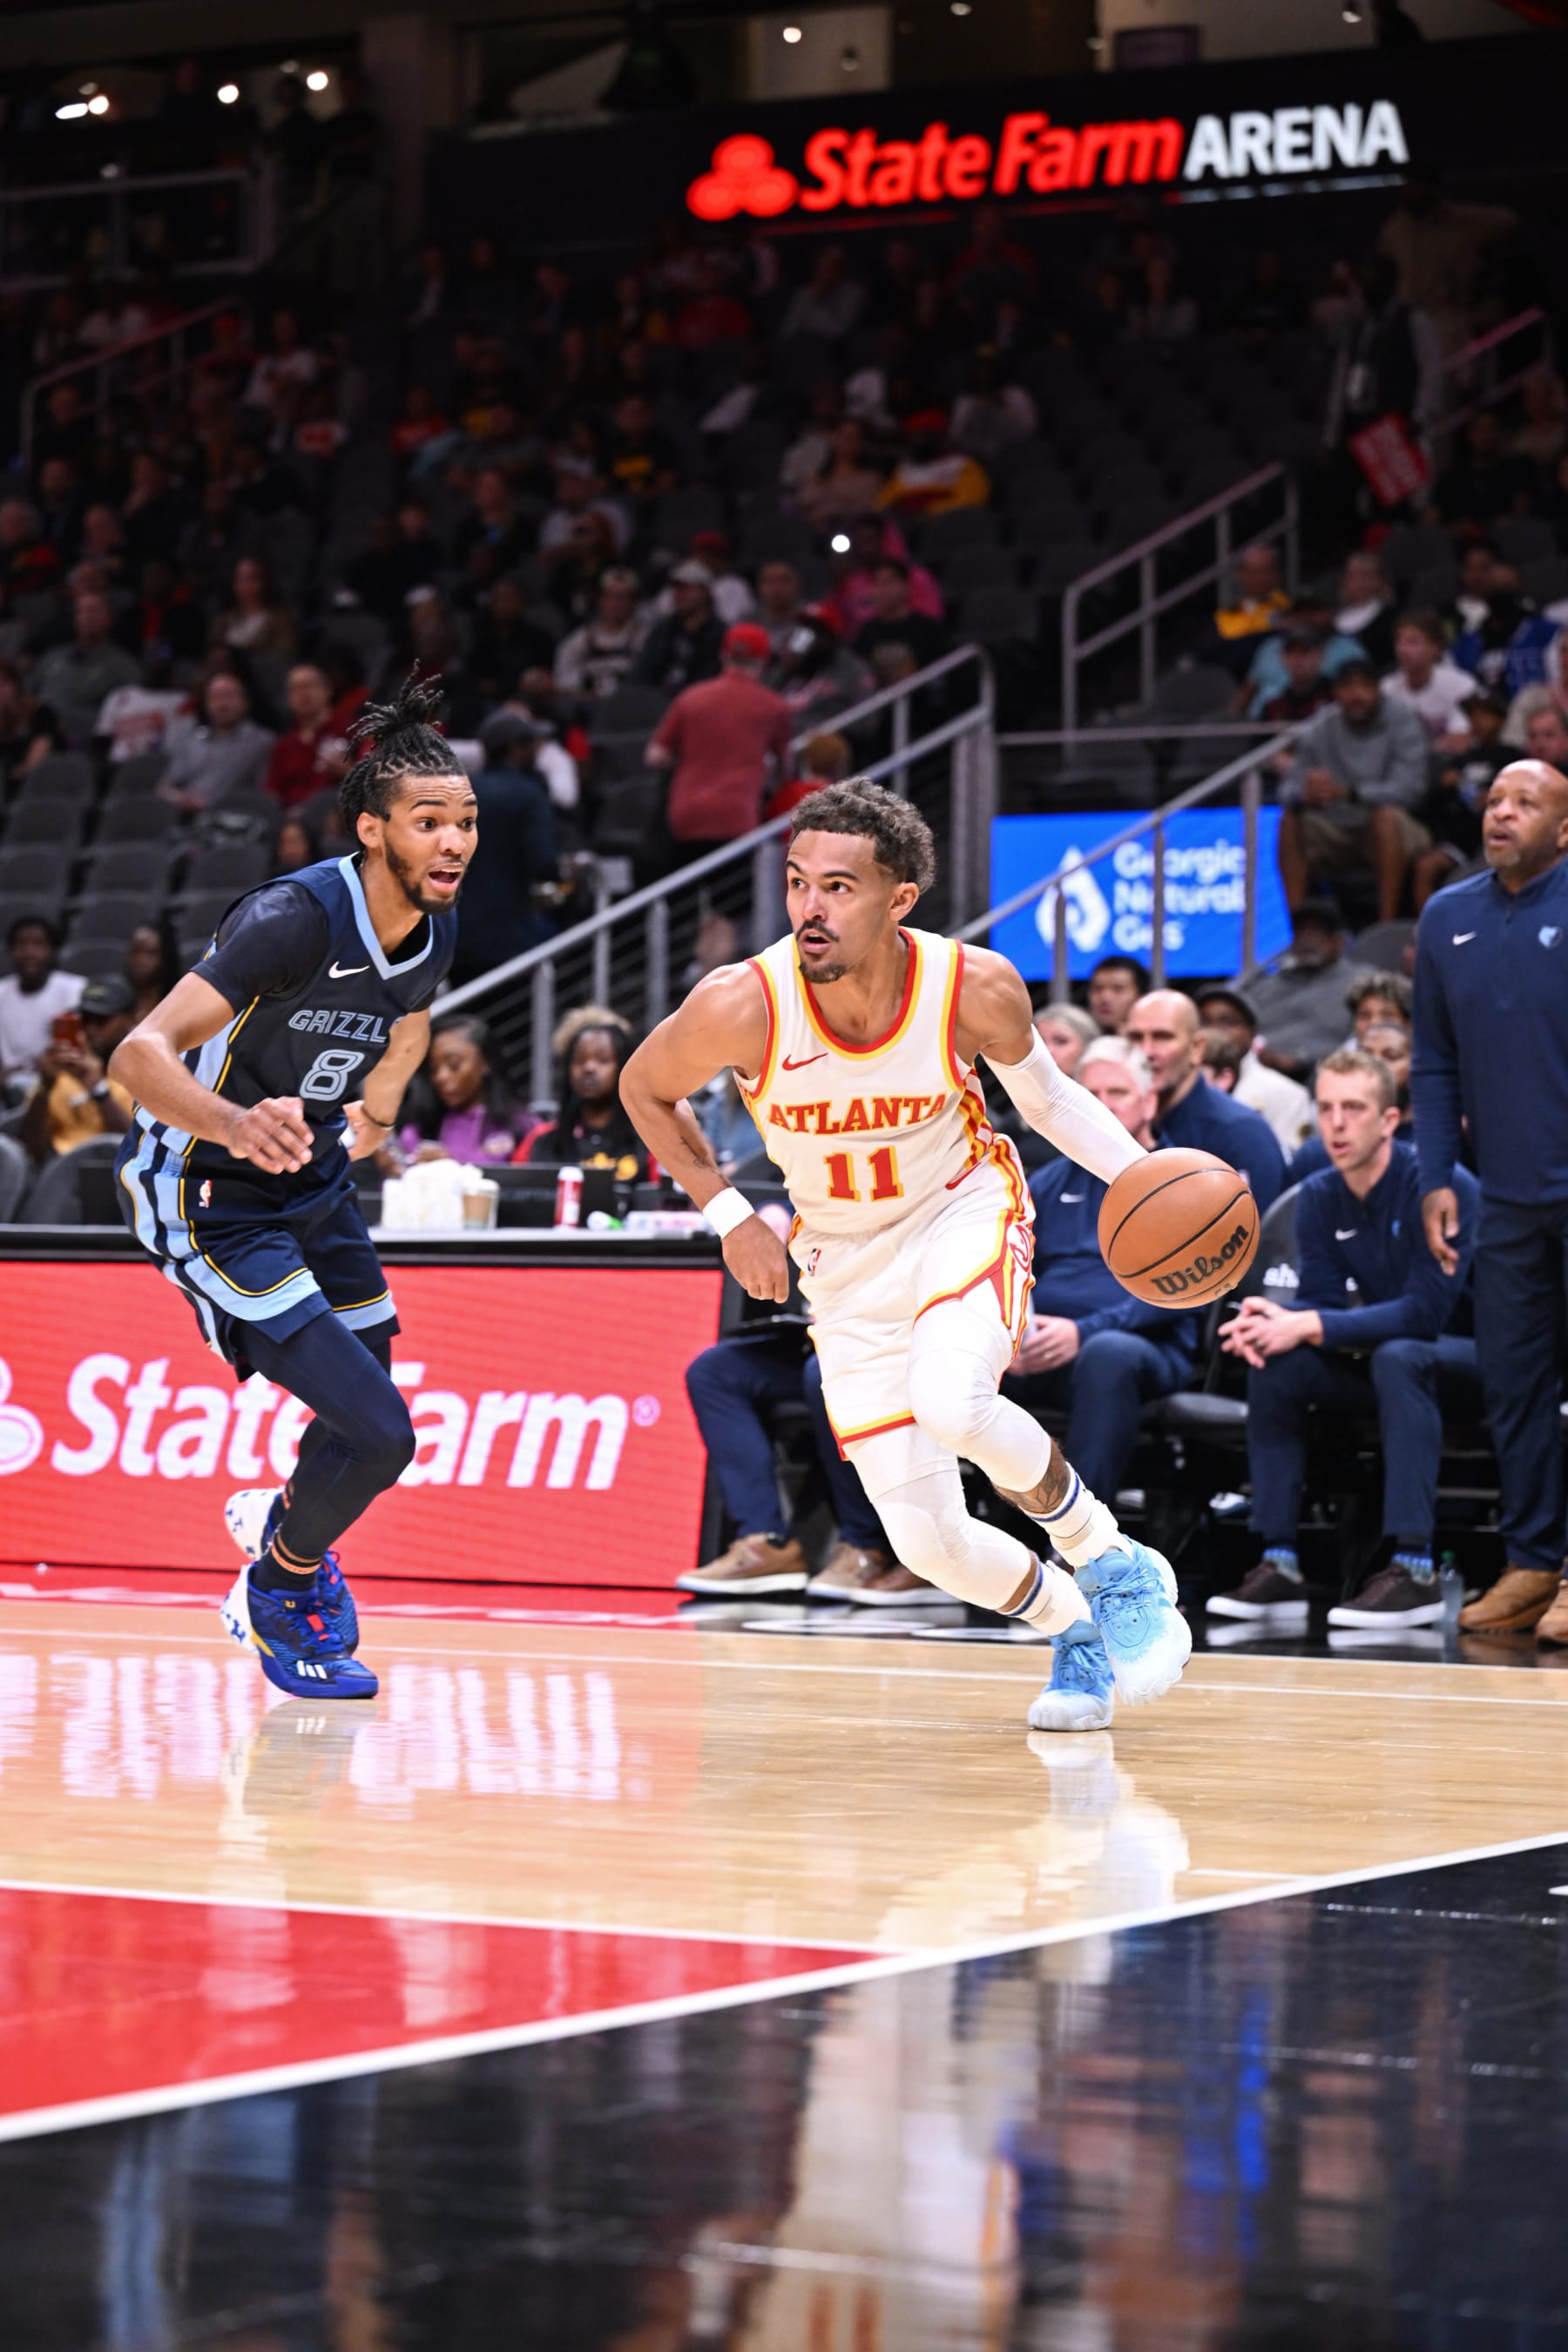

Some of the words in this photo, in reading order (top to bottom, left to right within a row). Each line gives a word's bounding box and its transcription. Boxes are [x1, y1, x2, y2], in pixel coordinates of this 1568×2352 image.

[799, 122, 991, 213] State
[993, 112, 1185, 194] Farm
[1185, 100, 1408, 179] ARENA
[288, 1010, 405, 1043] GRIZZL
[299, 1048, 365, 1101] 8
[768, 1093, 947, 1135] ATLANTA
[823, 1146, 904, 1202] 11
[1150, 1225, 1249, 1295] Wilson
[391, 1361, 629, 1490] arm
